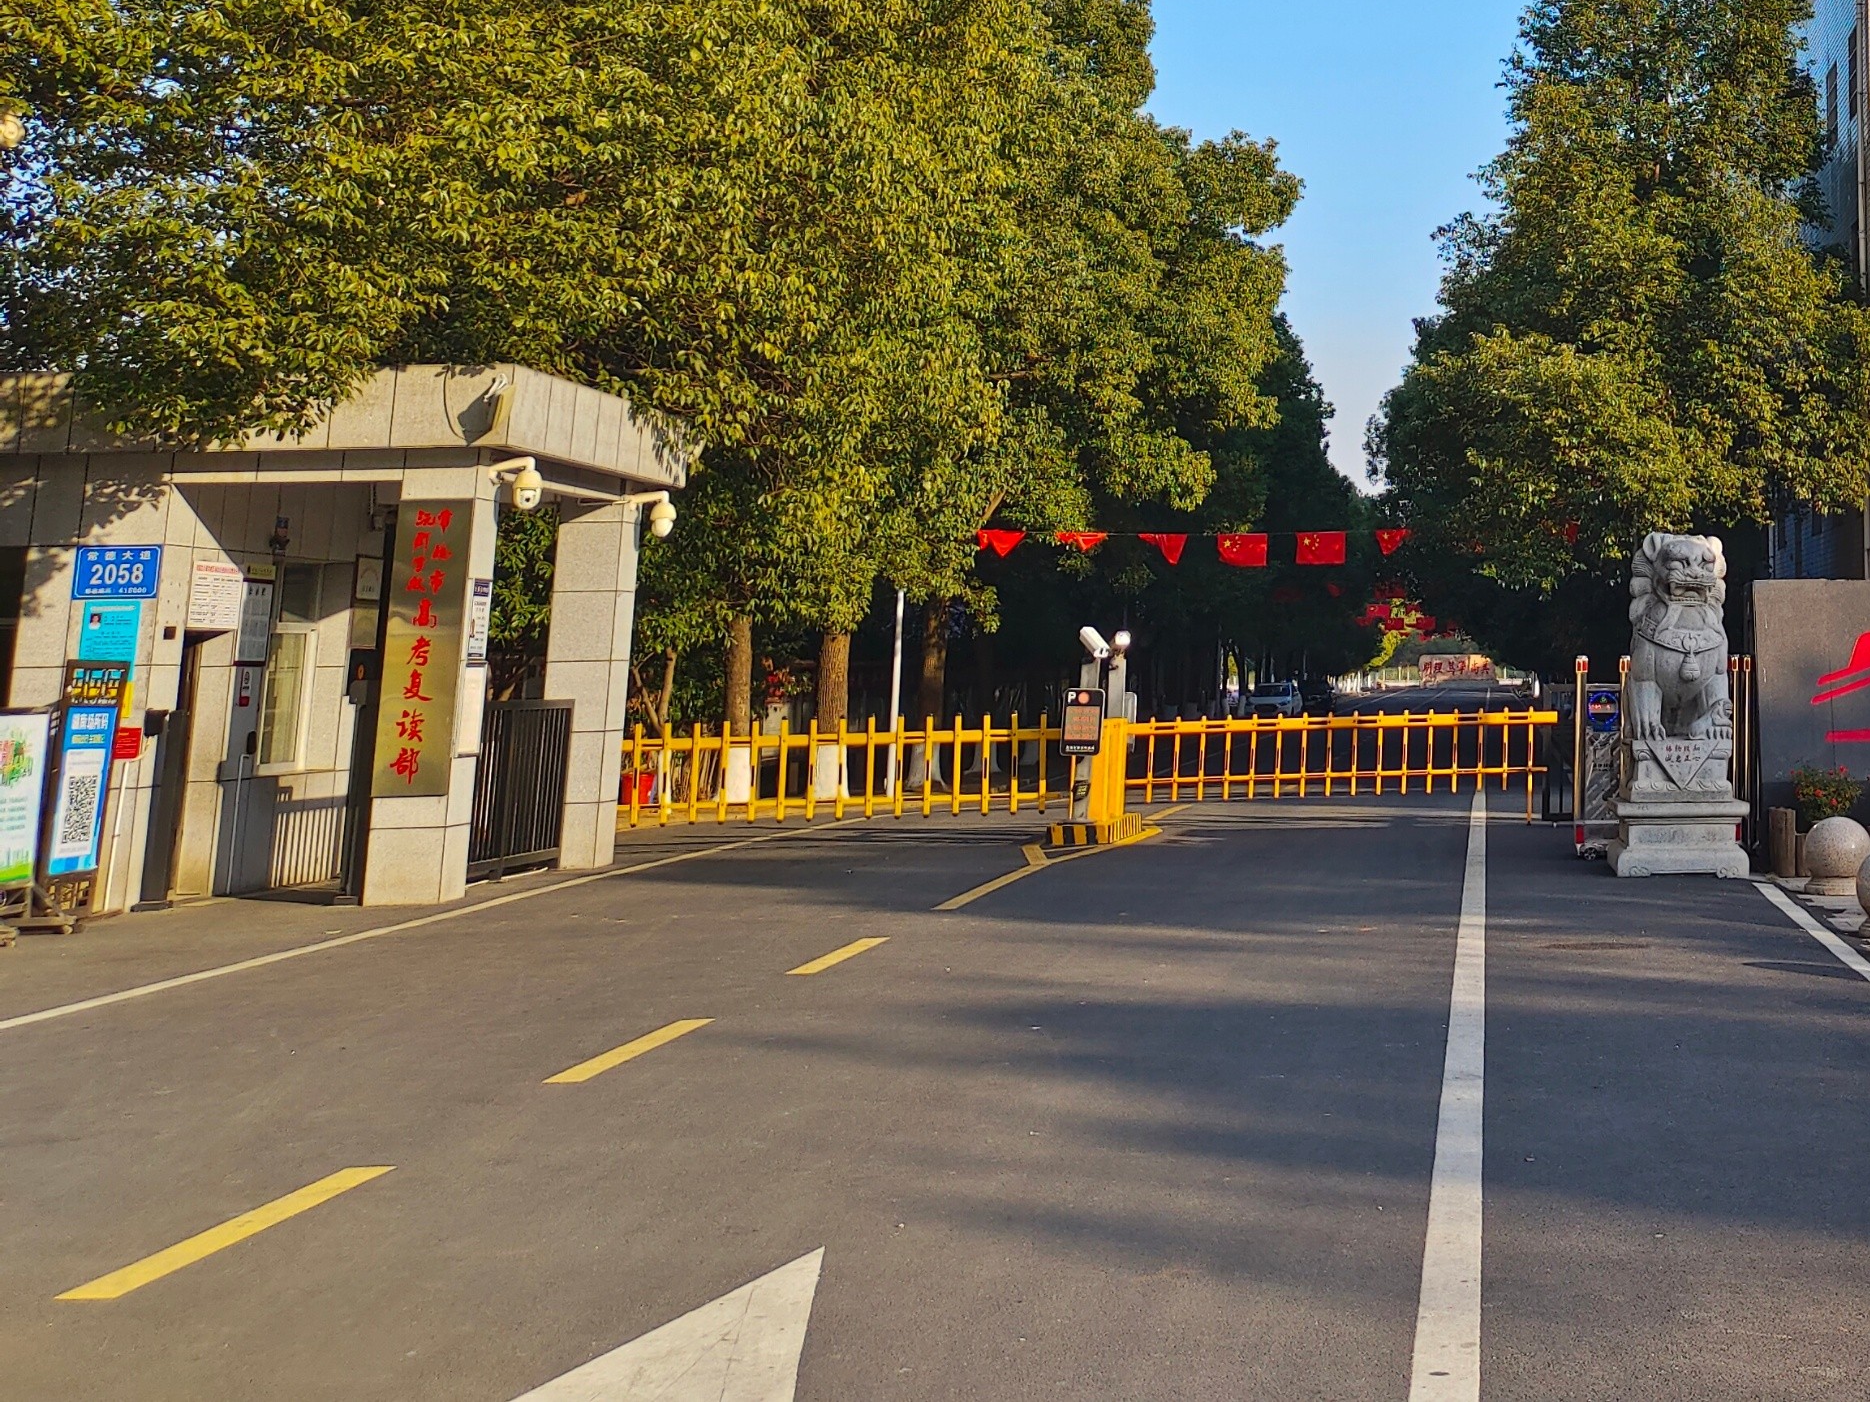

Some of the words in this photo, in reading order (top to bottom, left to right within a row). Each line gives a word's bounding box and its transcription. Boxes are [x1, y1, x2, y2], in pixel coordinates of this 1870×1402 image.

[86, 550, 152, 561] 常德大道
[89, 563, 144, 585] 2058
[390, 598, 438, 785] 高考复读部
[1068, 691, 1077, 703] P
